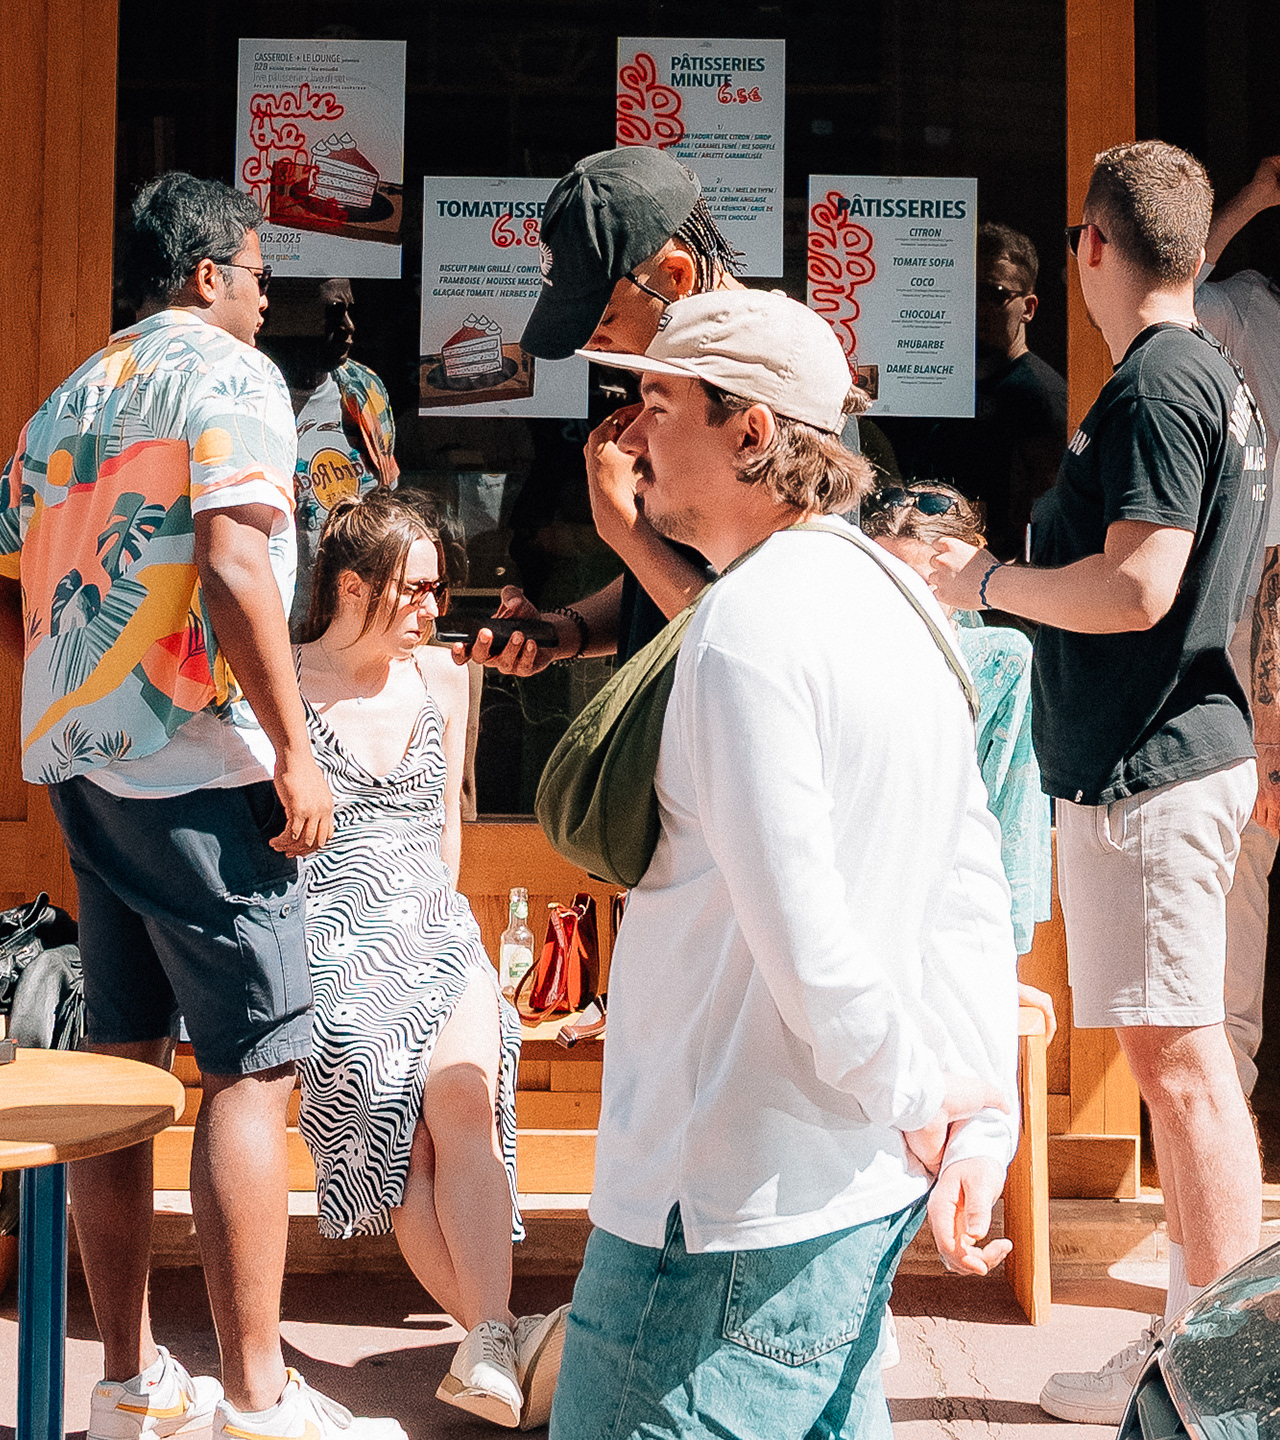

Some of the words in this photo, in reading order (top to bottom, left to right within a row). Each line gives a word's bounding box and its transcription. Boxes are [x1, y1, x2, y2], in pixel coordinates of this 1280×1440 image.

[254, 52, 293, 62] CASSEROLE
[303, 53, 311, 62] LE
[312, 54, 340, 63] LOUNGE
[671, 53, 766, 72] PÂTISSERIES
[254, 62, 268, 71] B2B
[671, 73, 733, 87] MINUTE
[250, 82, 345, 121] make
[837, 193, 967, 220] PÂTISSERIES
[909, 228, 942, 237] CITRON
[892, 257, 927, 267] TOMATE
[928, 258, 955, 267] SOFIA
[439, 265, 467, 273] BISCUIT
[468, 265, 485, 273] PAIN
[486, 264, 511, 273] GRILLÉ
[439, 277, 480, 285] FRAMBOISE
[486, 277, 517, 286] MOUSSE
[910, 277, 935, 287] COCO
[432, 289, 464, 298] GLAÇAGE
[466, 289, 494, 297] TOMATE
[499, 290, 527, 298] HERBES
[899, 309, 946, 320] CHOCOLAT
[896, 339, 945, 349] RHUBARBE
[886, 364, 912, 374] DAME
[913, 364, 955, 375] BLANCHE
